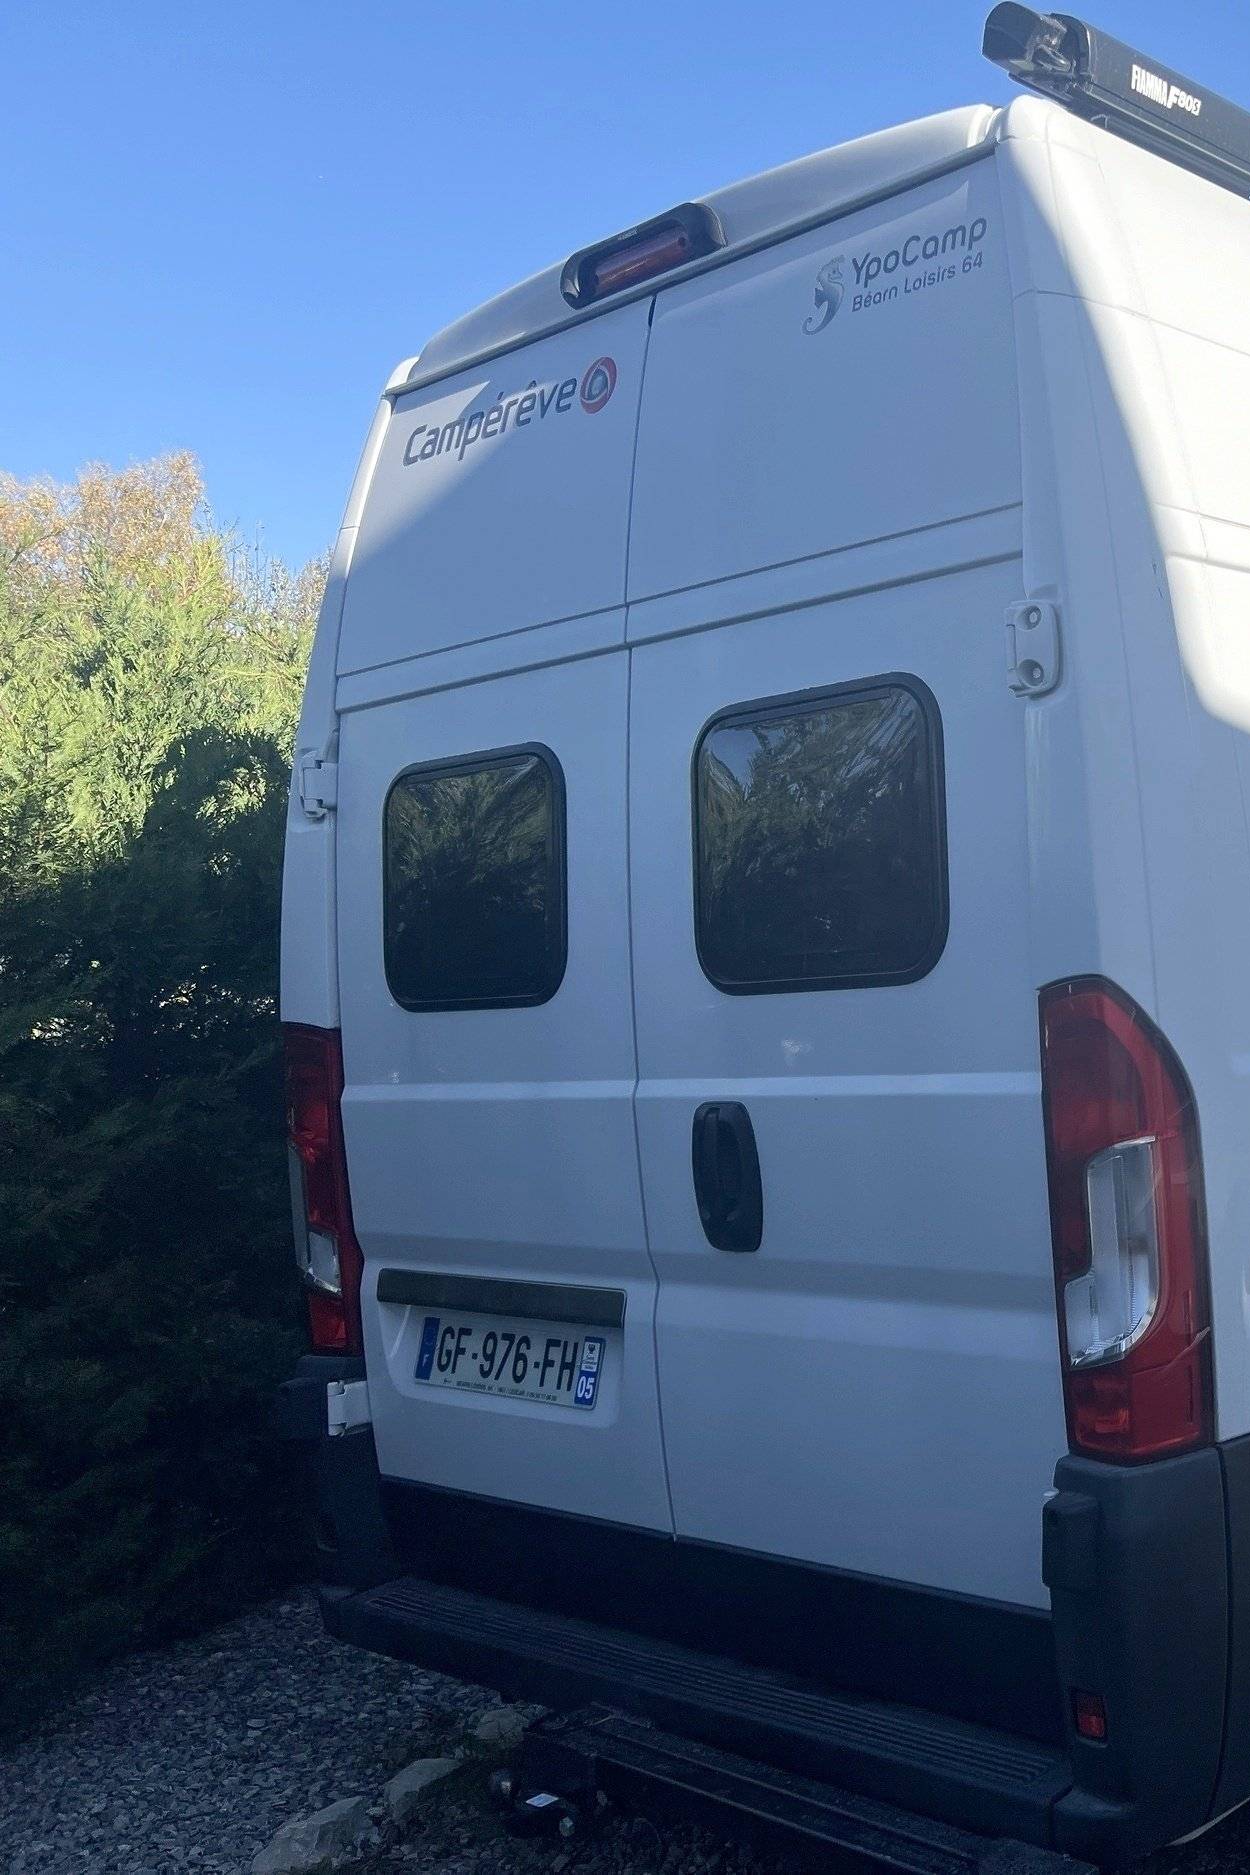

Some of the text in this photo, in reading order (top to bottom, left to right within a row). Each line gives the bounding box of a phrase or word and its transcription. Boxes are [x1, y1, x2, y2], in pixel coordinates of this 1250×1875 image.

[1131, 64, 1168, 107] FIAMMA
[852, 218, 987, 288] YpoCamp
[852, 251, 984, 312] Béarn Loisirs 64
[402, 377, 579, 467] Campérêve
[436, 1326, 579, 1392] GF-976-FH
[577, 1375, 596, 1400] 05
